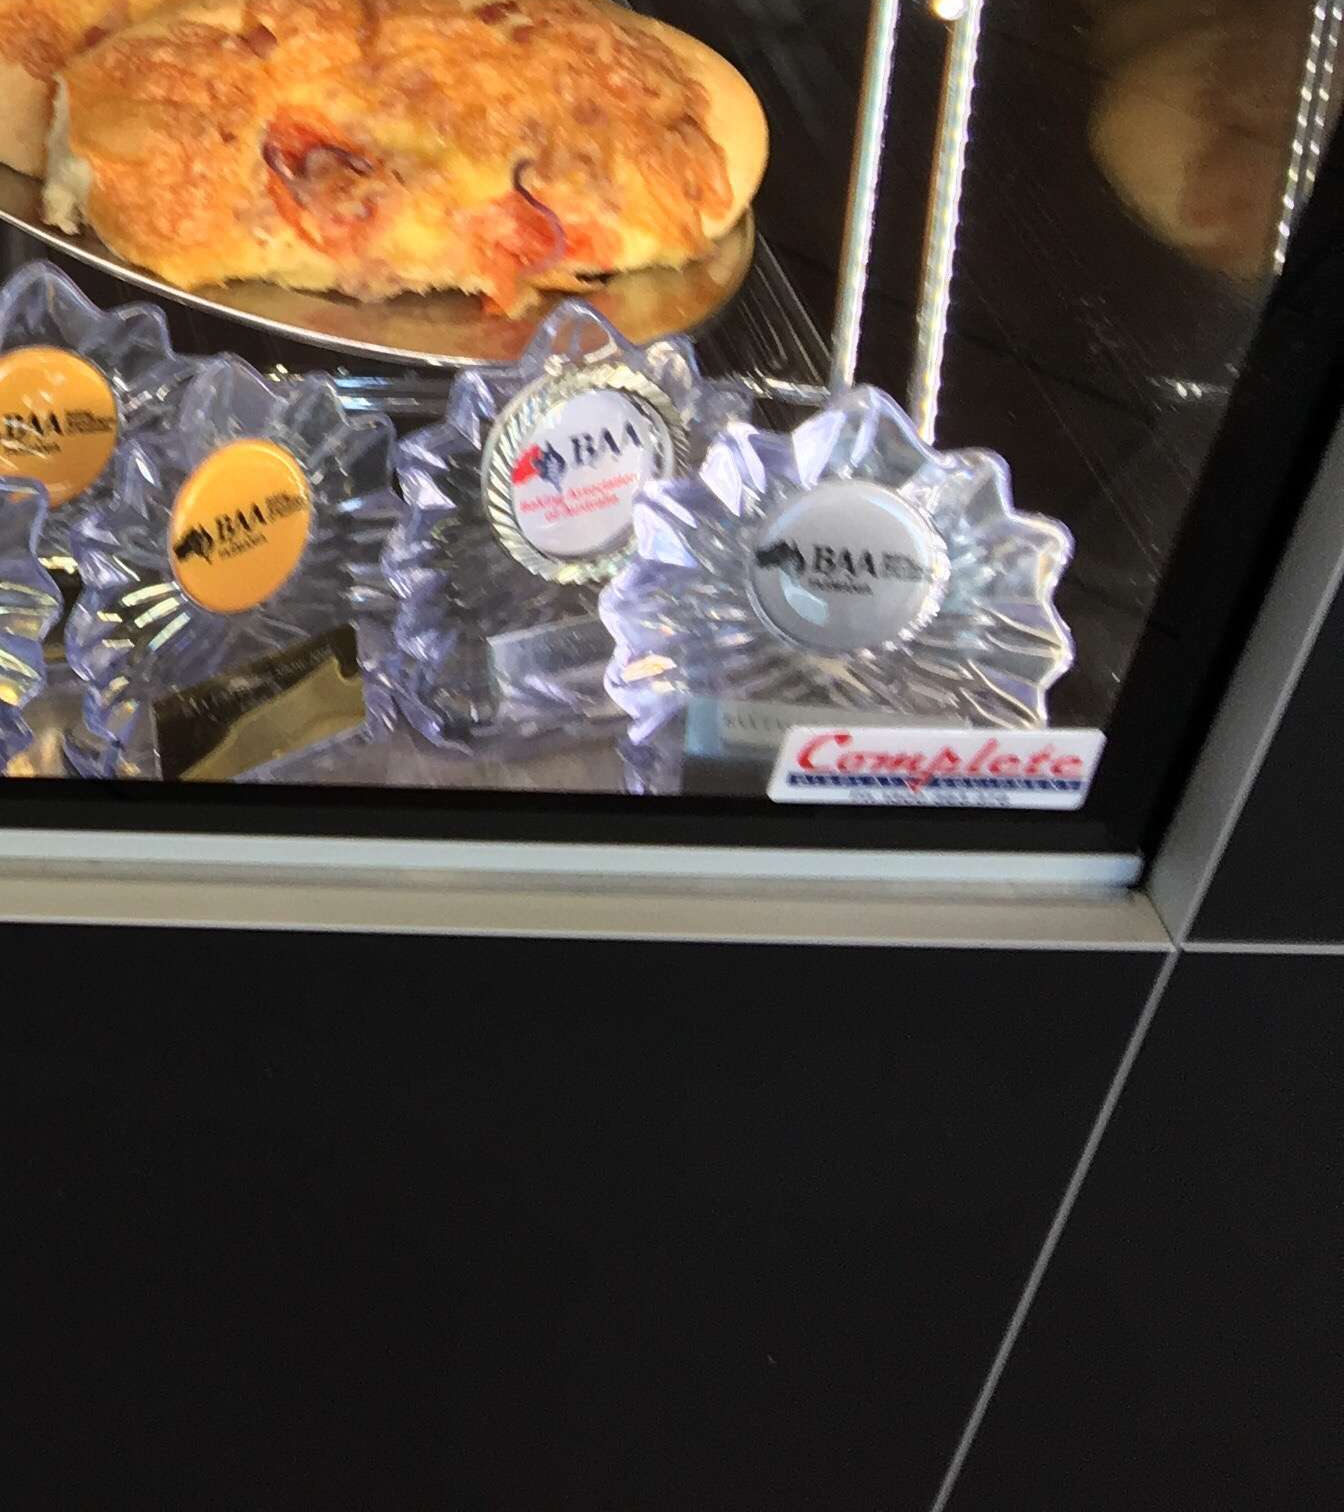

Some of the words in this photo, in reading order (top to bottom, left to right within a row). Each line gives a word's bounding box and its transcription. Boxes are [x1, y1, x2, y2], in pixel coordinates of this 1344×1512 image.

[569, 419, 644, 470] BAA
[215, 501, 268, 542] BAA
[813, 543, 879, 580] BAA
[796, 730, 1083, 793] Complete
